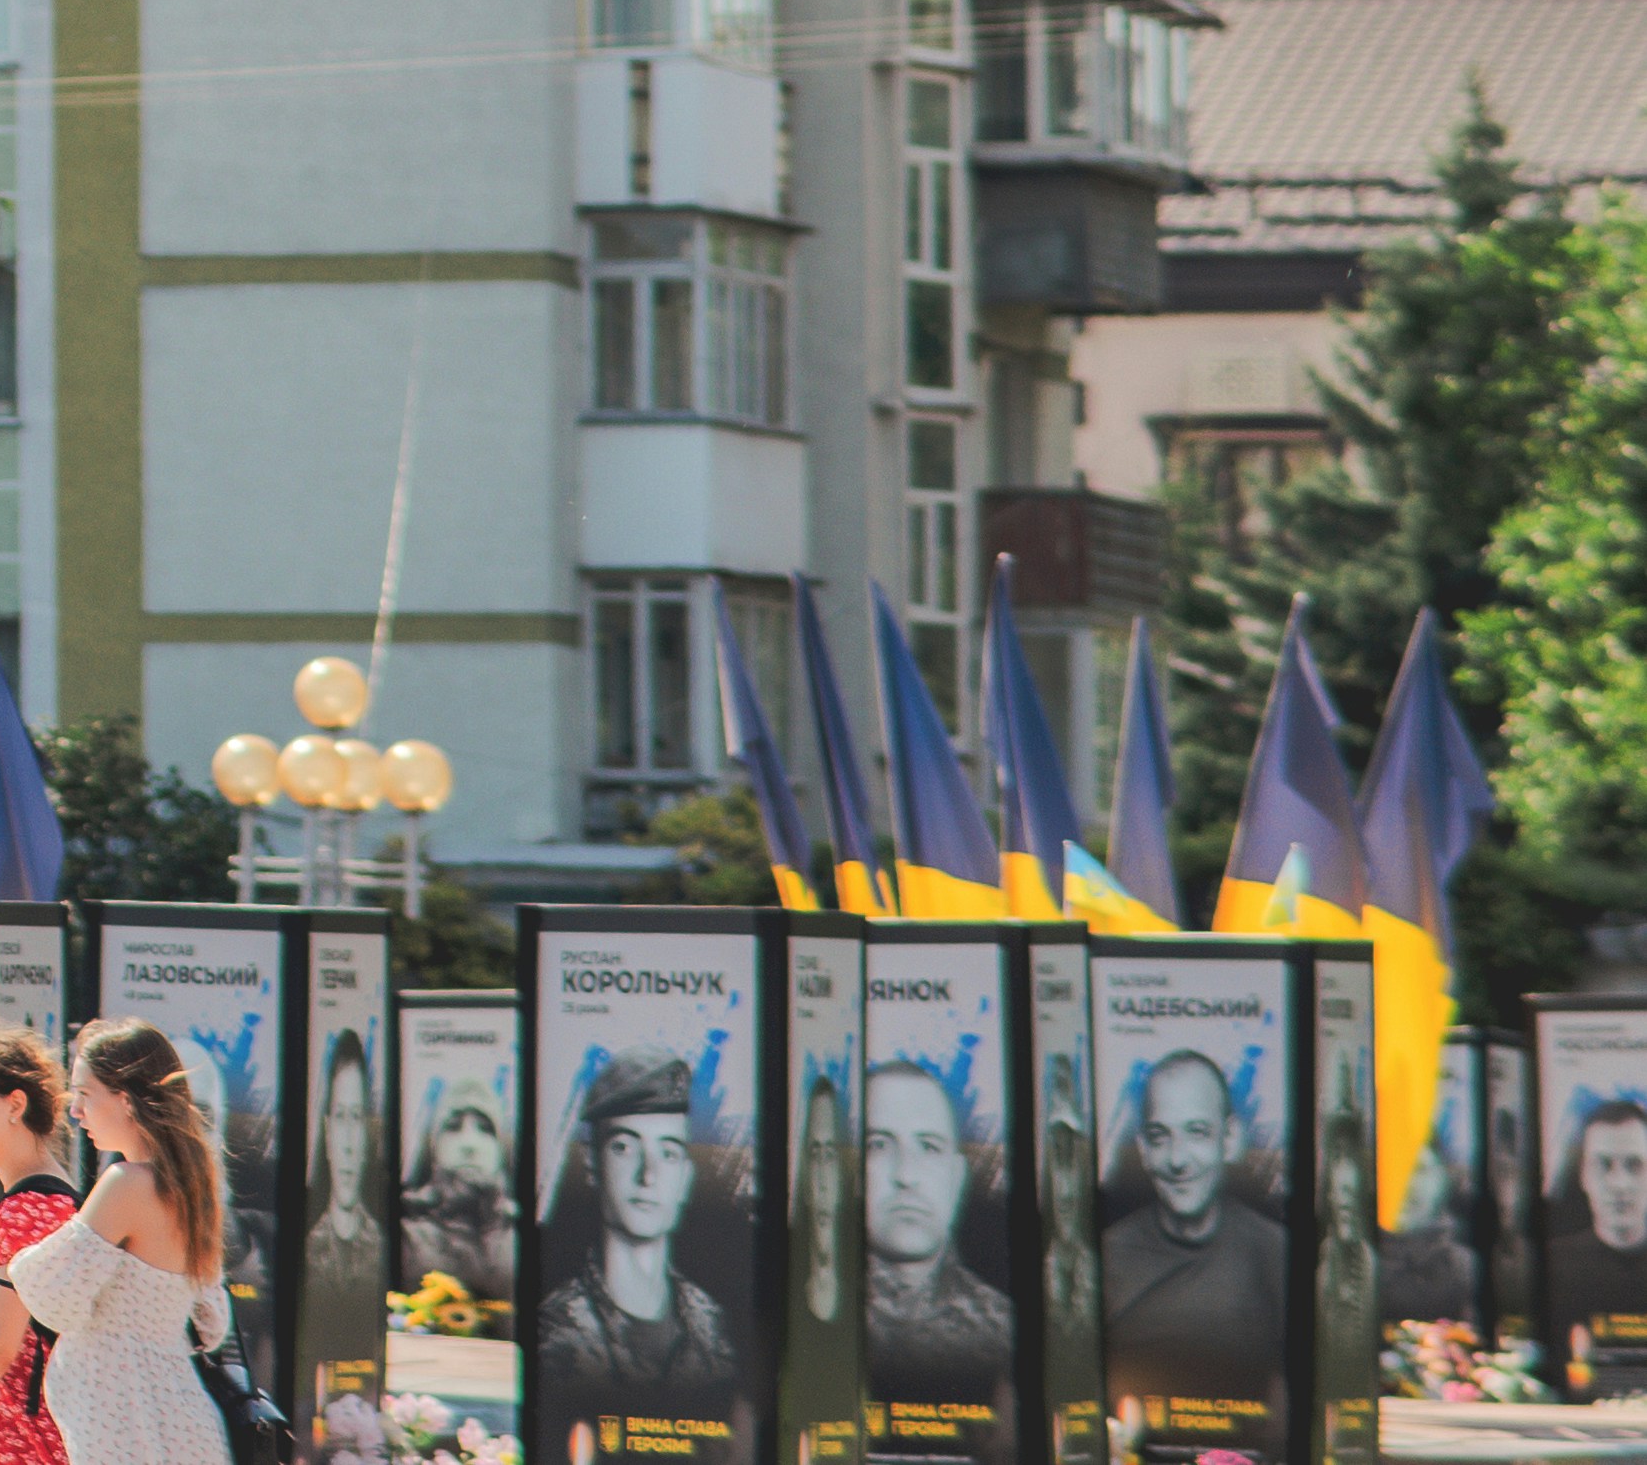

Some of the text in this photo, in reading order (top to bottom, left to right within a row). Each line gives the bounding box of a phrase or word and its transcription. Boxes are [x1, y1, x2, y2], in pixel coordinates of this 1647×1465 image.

[561, 950, 622, 965] РУСЛАН
[123, 961, 258, 986] ЛАЗОВСЬКИЙ
[562, 970, 725, 995] КОРОЛЬЧУК
[863, 978, 951, 1002] ЯНЮК
[1110, 991, 1260, 1018] КАДЕБСЬКИЙ
